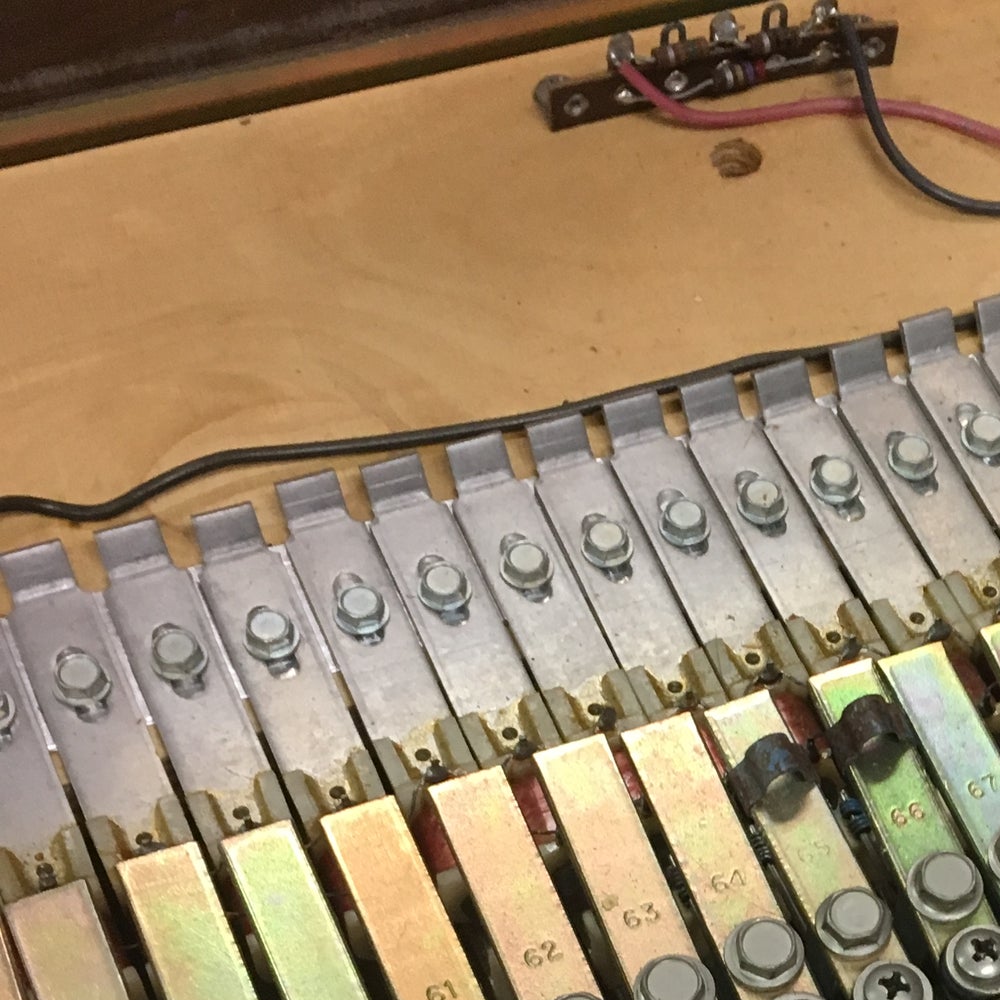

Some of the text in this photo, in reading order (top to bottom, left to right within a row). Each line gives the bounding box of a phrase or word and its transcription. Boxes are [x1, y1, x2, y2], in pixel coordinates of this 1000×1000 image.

[967, 774, 999, 800] 67
[890, 802, 925, 828] 66
[711, 869, 747, 893] 64
[623, 902, 660, 929] 63
[523, 939, 564, 969] 62
